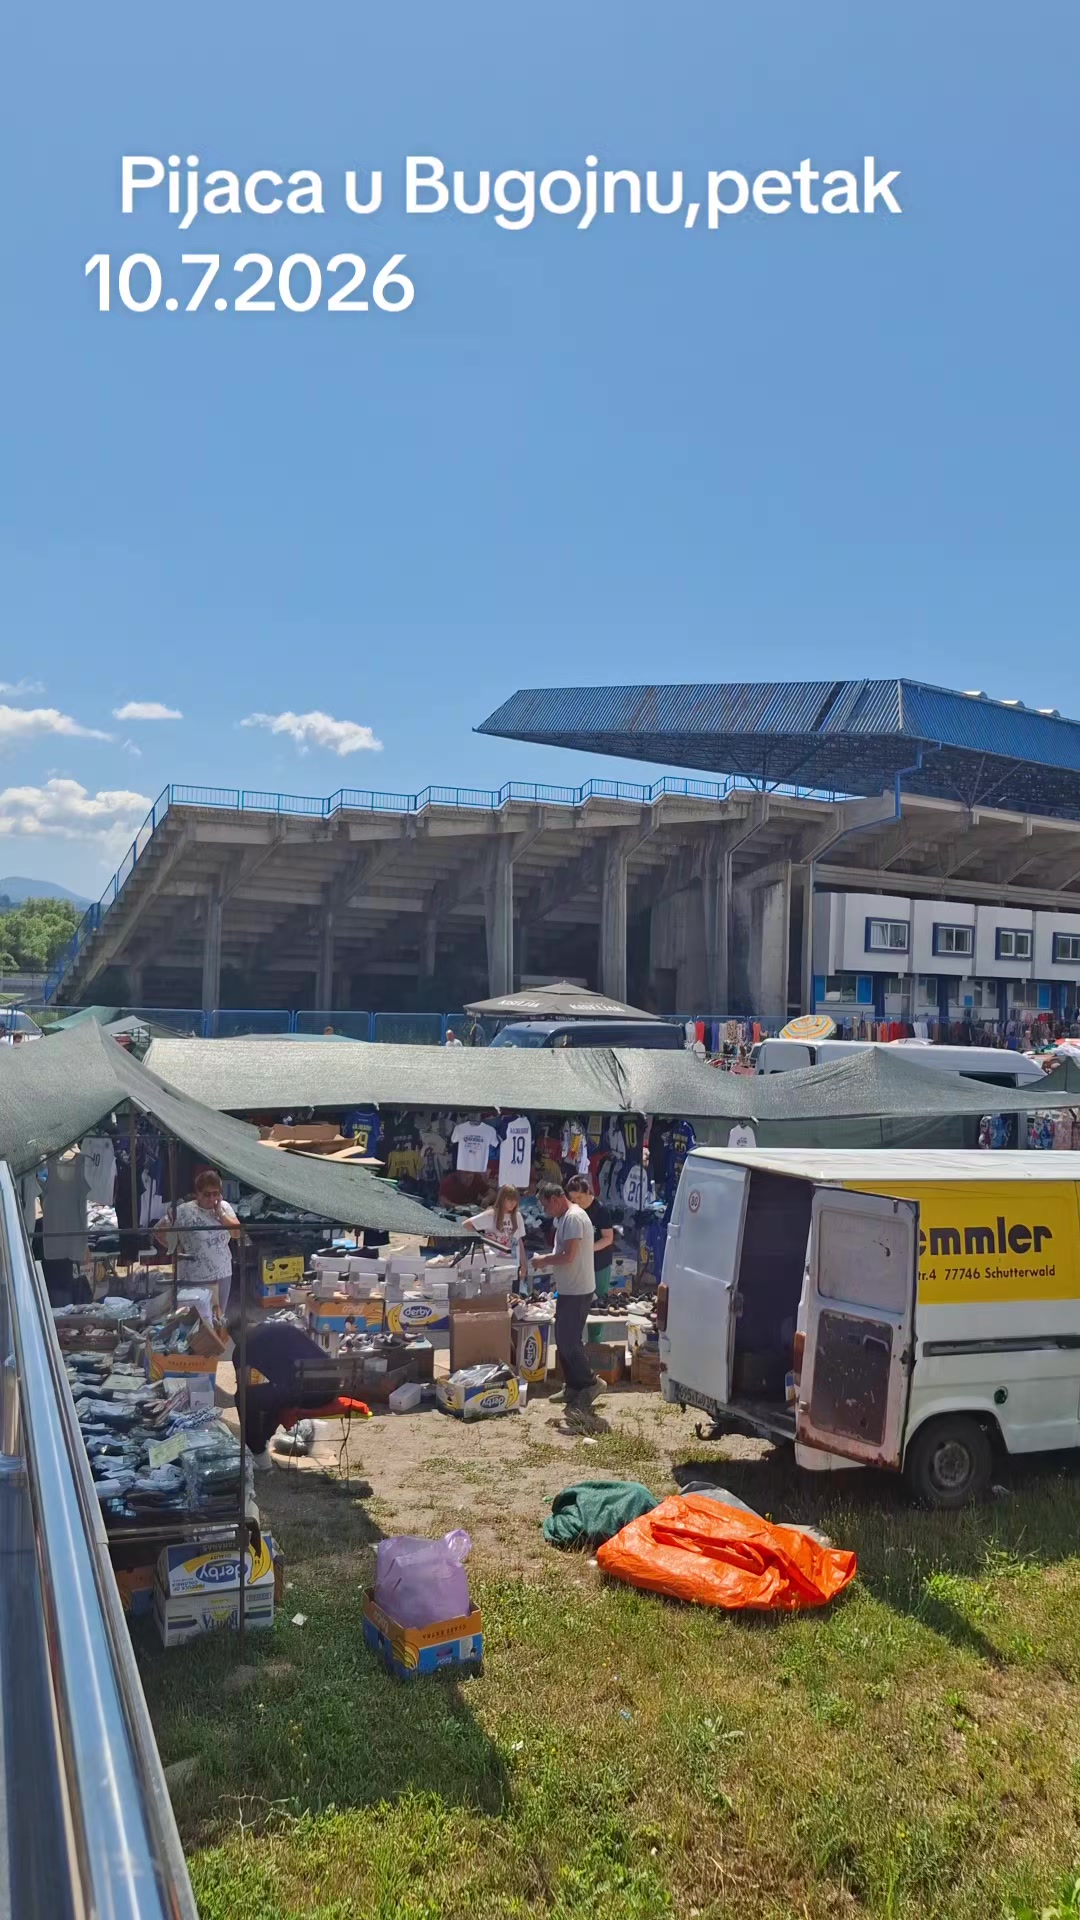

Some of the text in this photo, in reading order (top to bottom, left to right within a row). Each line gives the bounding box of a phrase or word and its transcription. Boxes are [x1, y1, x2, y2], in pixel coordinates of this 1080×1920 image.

[623, 1122, 637, 1148] 10
[510, 1136, 526, 1165] 19
[944, 1267, 981, 1281] 77746
[984, 1264, 1056, 1279] Schutterwald
[405, 1306, 431, 1317] derby
[525, 1338, 536, 1366] derby
[482, 1396, 504, 1407] derby
